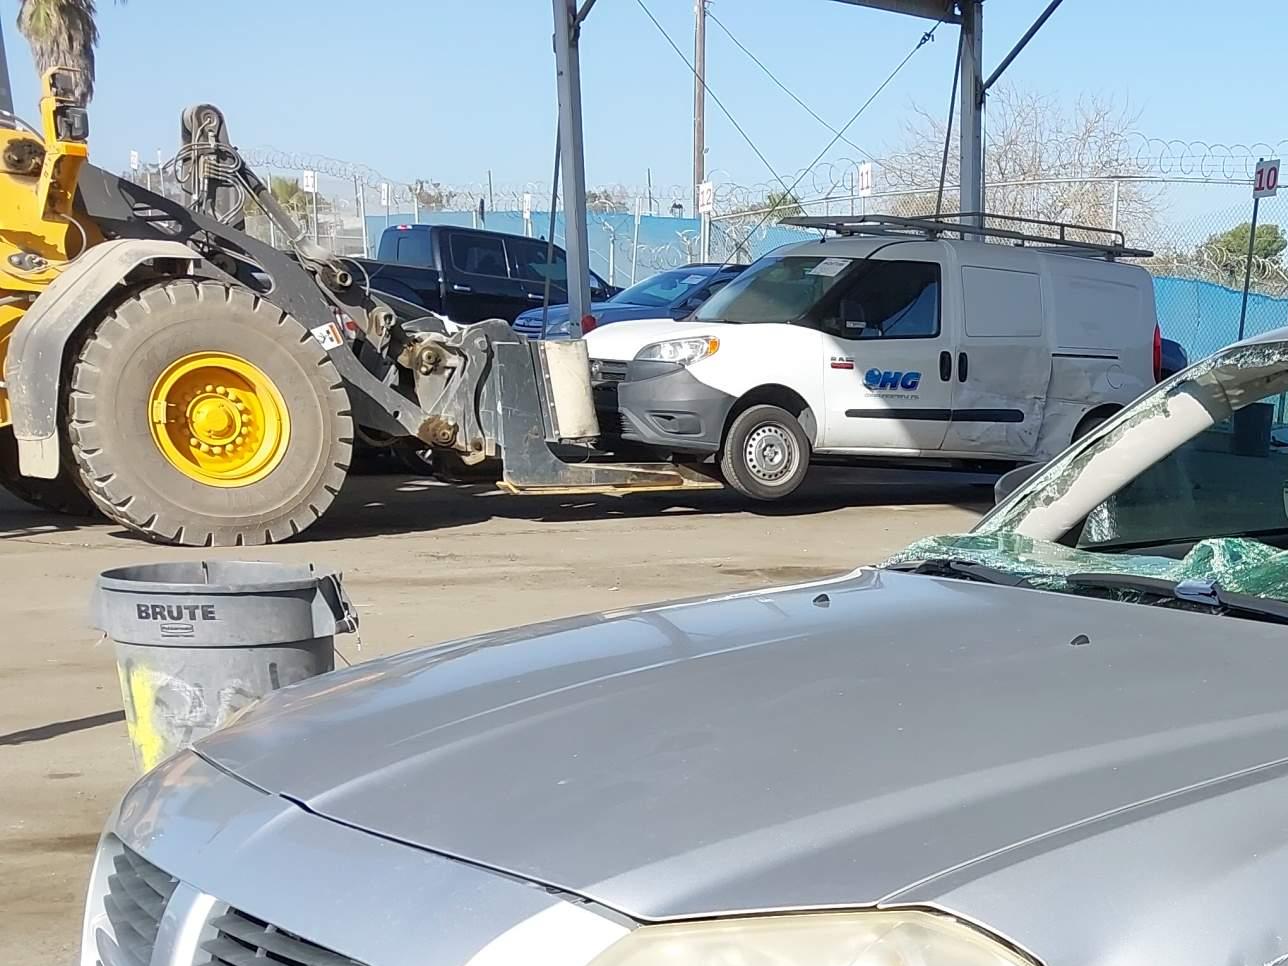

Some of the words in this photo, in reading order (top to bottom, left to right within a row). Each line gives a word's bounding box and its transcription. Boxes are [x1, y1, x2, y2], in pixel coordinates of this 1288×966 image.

[860, 170, 870, 191] 11
[1255, 167, 1277, 191] 10
[700, 188, 712, 207] 12
[137, 604, 216, 620] BRUTE
